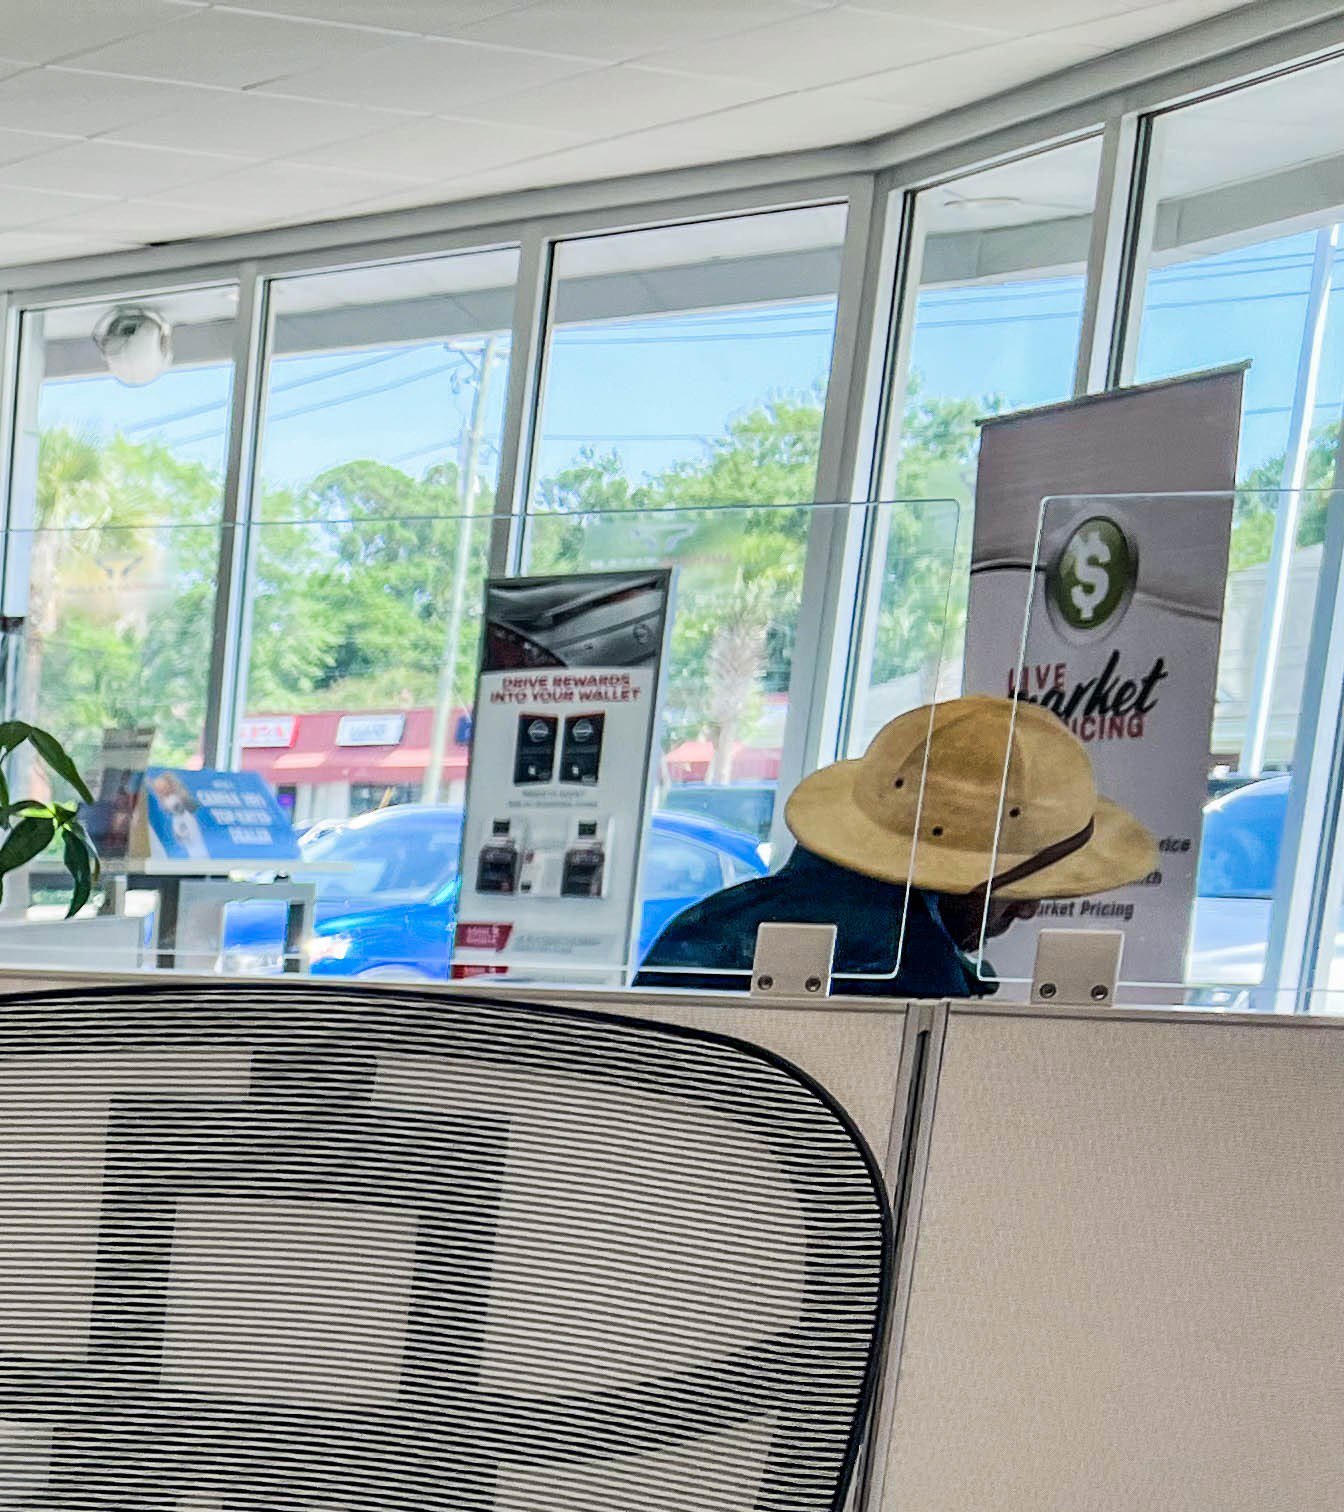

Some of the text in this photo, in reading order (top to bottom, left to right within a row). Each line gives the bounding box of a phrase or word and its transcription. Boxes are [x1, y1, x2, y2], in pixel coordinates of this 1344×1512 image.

[501, 673, 631, 688] DRIVE REWARDS
[1008, 663, 1067, 694] LIVE
[489, 688, 642, 703] INTO YOUR WALLET
[1080, 901, 1135, 921] Pricing
